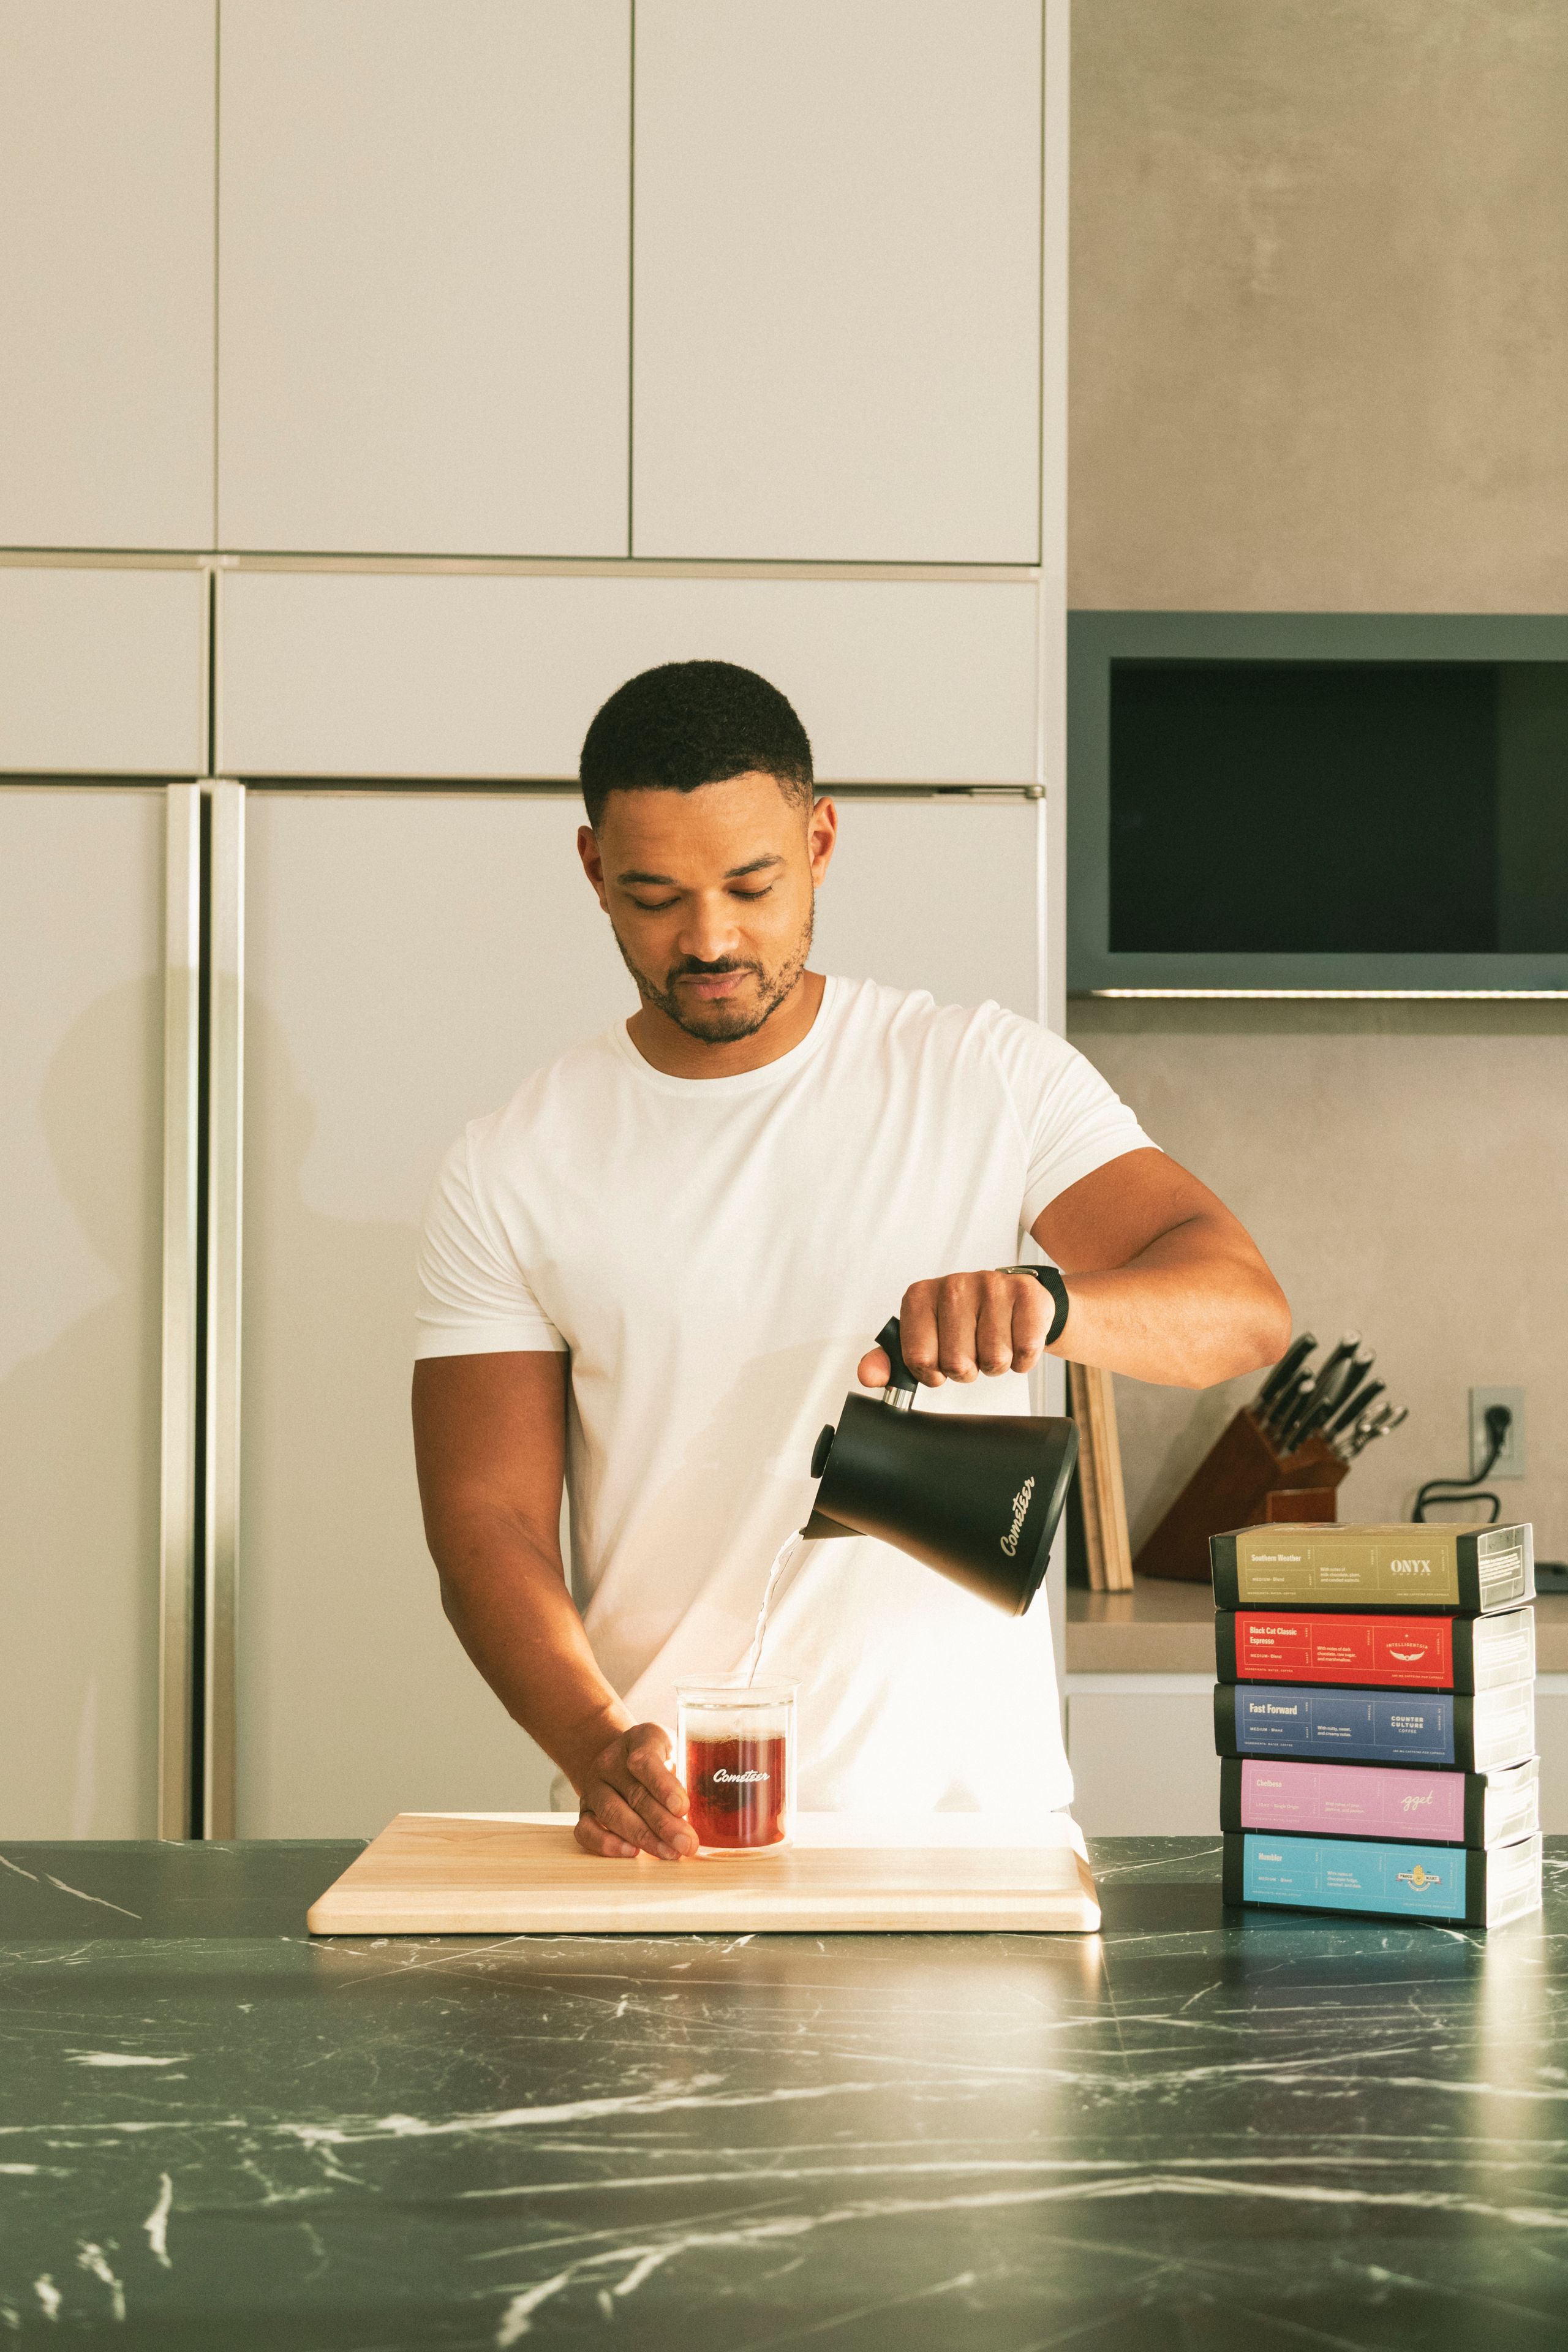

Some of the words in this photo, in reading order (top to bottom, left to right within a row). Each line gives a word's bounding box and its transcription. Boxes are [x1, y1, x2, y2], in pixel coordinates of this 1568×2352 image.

[1000, 1476, 1035, 1557] Cometeer
[1390, 1559, 1431, 1573] ONYX
[1277, 1627, 1297, 1636] Classic
[1250, 1636, 1275, 1645] Espresso
[1250, 1703, 1265, 1713] Fast
[1267, 1704, 1297, 1715] Forward
[713, 1768, 770, 1783] Cometeer
[1256, 1779, 1282, 1788] Chelbesa
[1400, 1790, 1433, 1811] gget
[1258, 1852, 1283, 1861] Humbler
